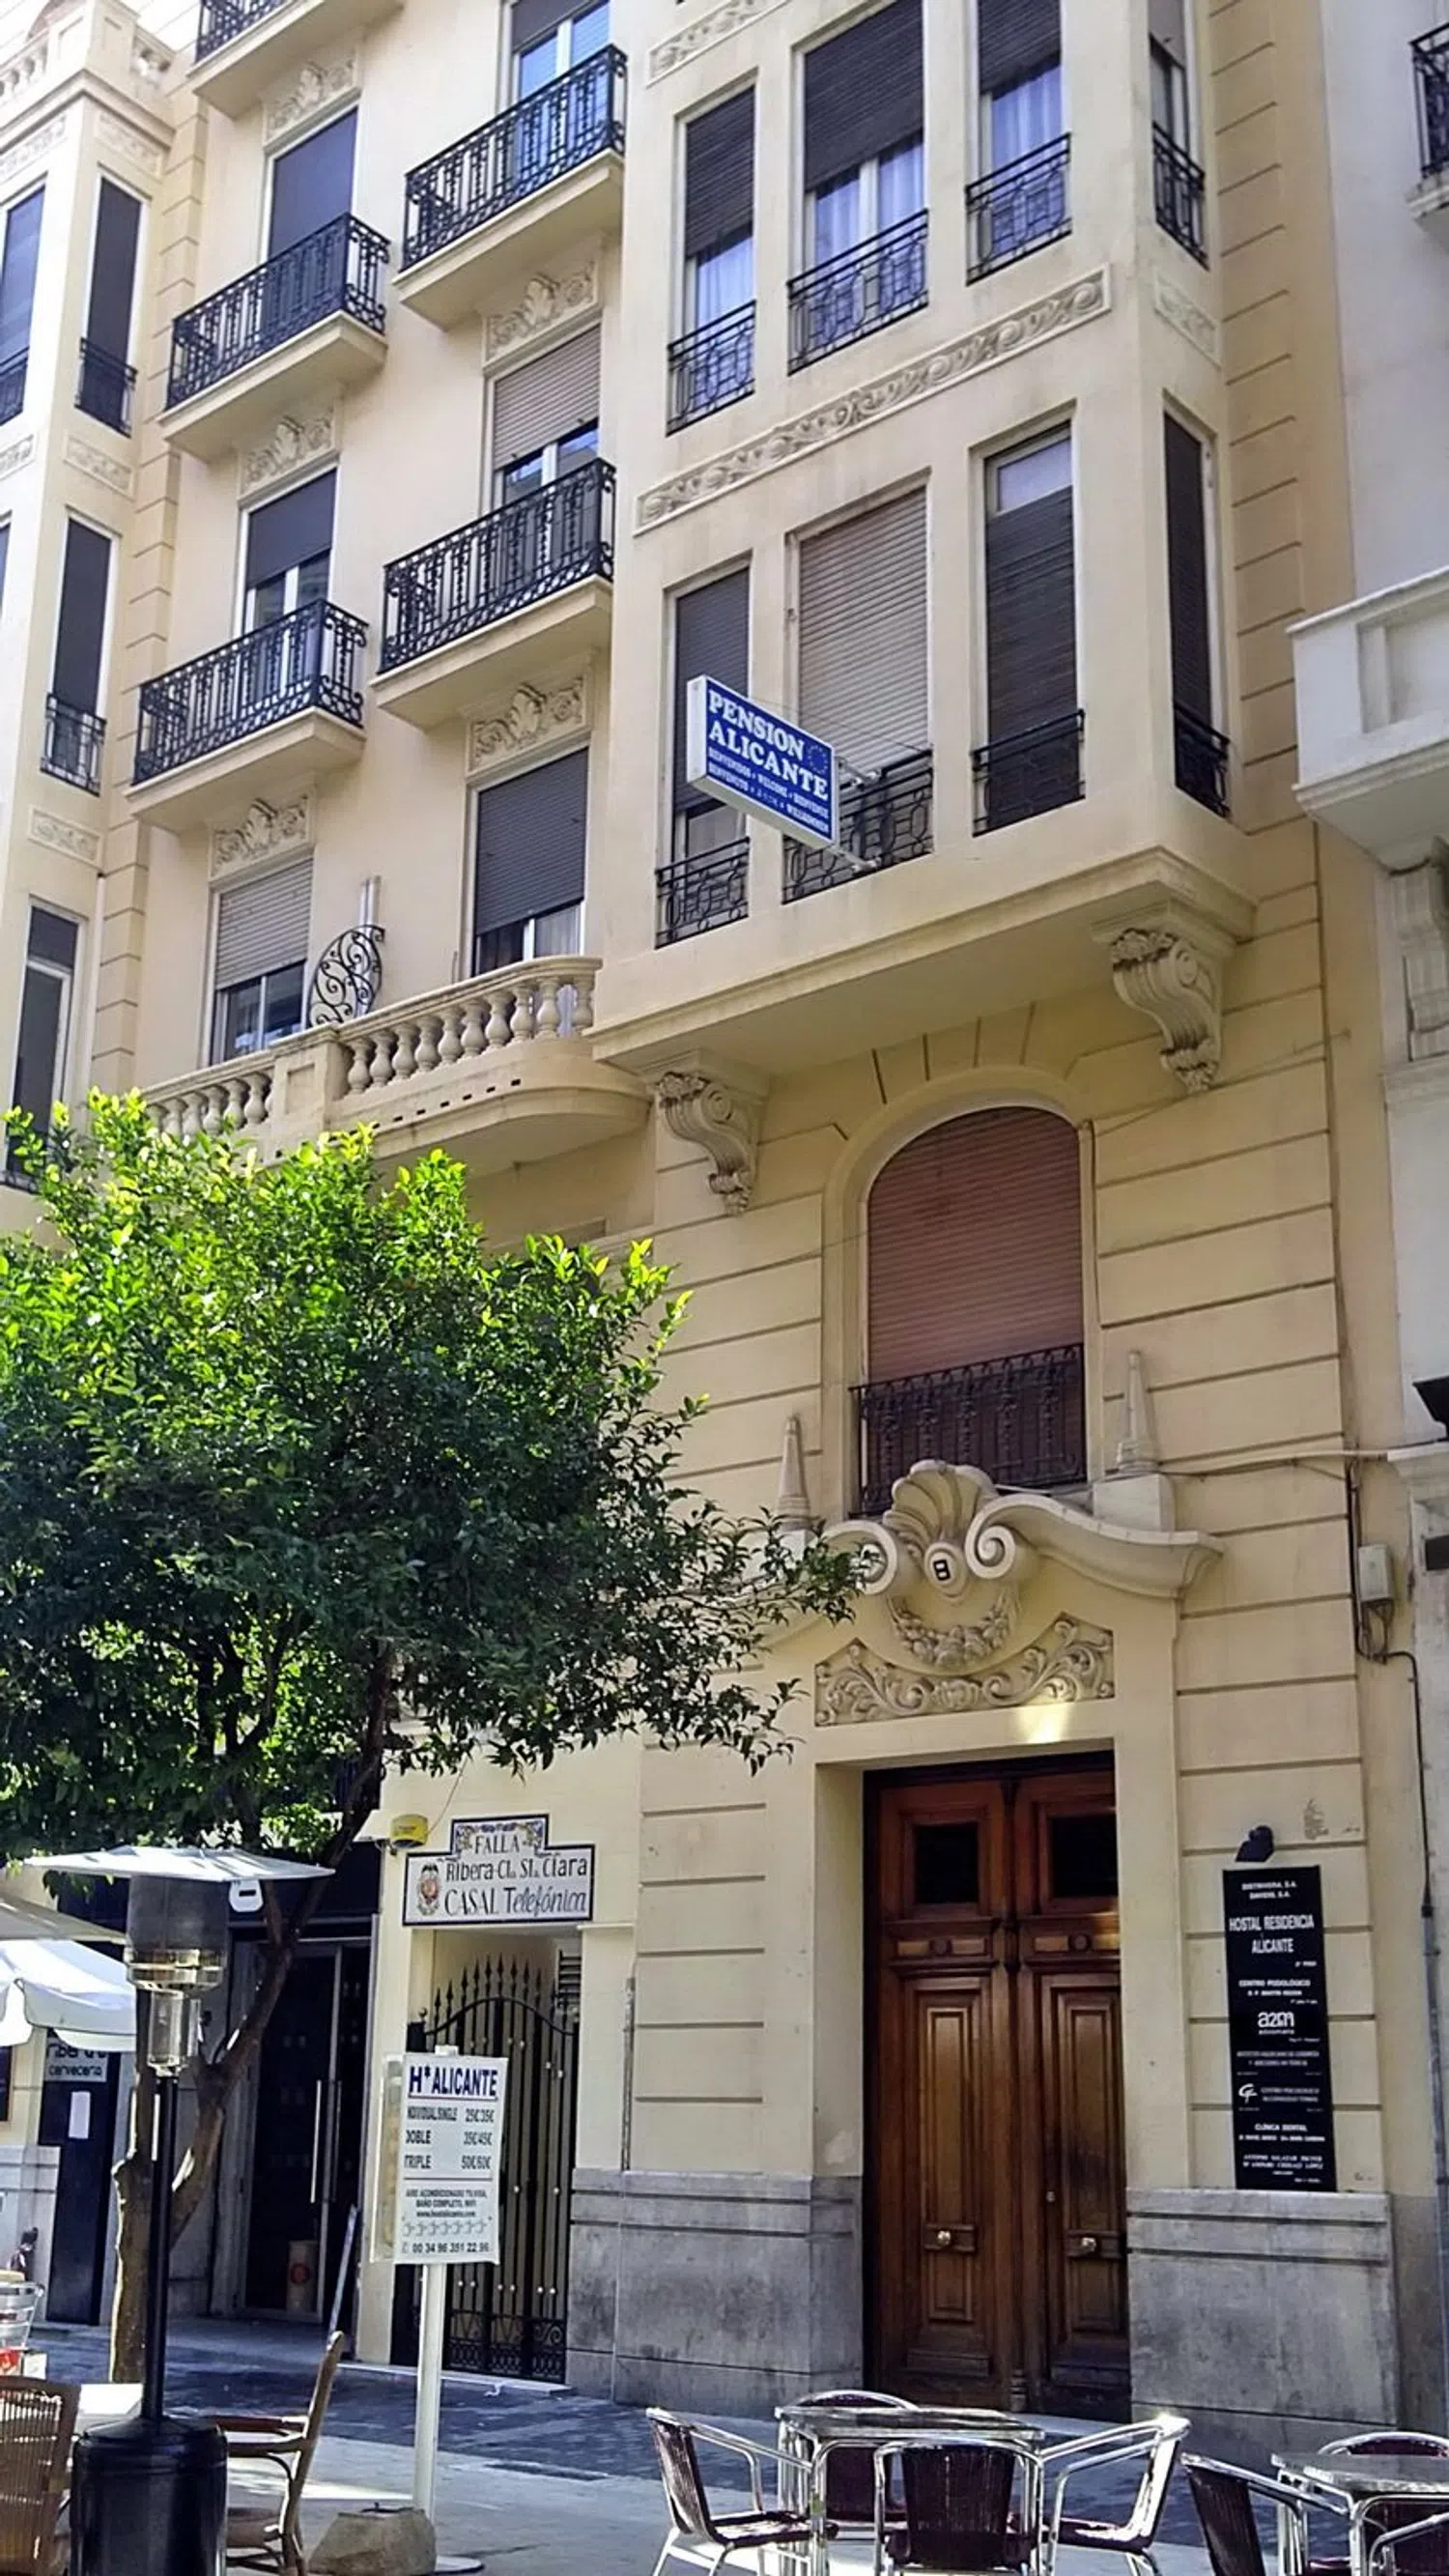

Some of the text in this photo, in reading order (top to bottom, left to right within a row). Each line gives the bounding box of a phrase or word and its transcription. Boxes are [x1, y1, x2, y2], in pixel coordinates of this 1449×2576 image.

[708, 689, 805, 761] PENSION
[709, 721, 829, 801] ALICANTE
[933, 1560, 952, 1582] 8
[474, 1834, 520, 1855] FALLA
[543, 1857, 588, 1877] Clara
[444, 1885, 587, 1918] CASAL Telefónica
[1229, 1914, 1315, 1932] HOSTAL RESIDENCIA
[1251, 1937, 1294, 1954] ALICANTE
[432, 2067, 497, 2097] ALICANTE
